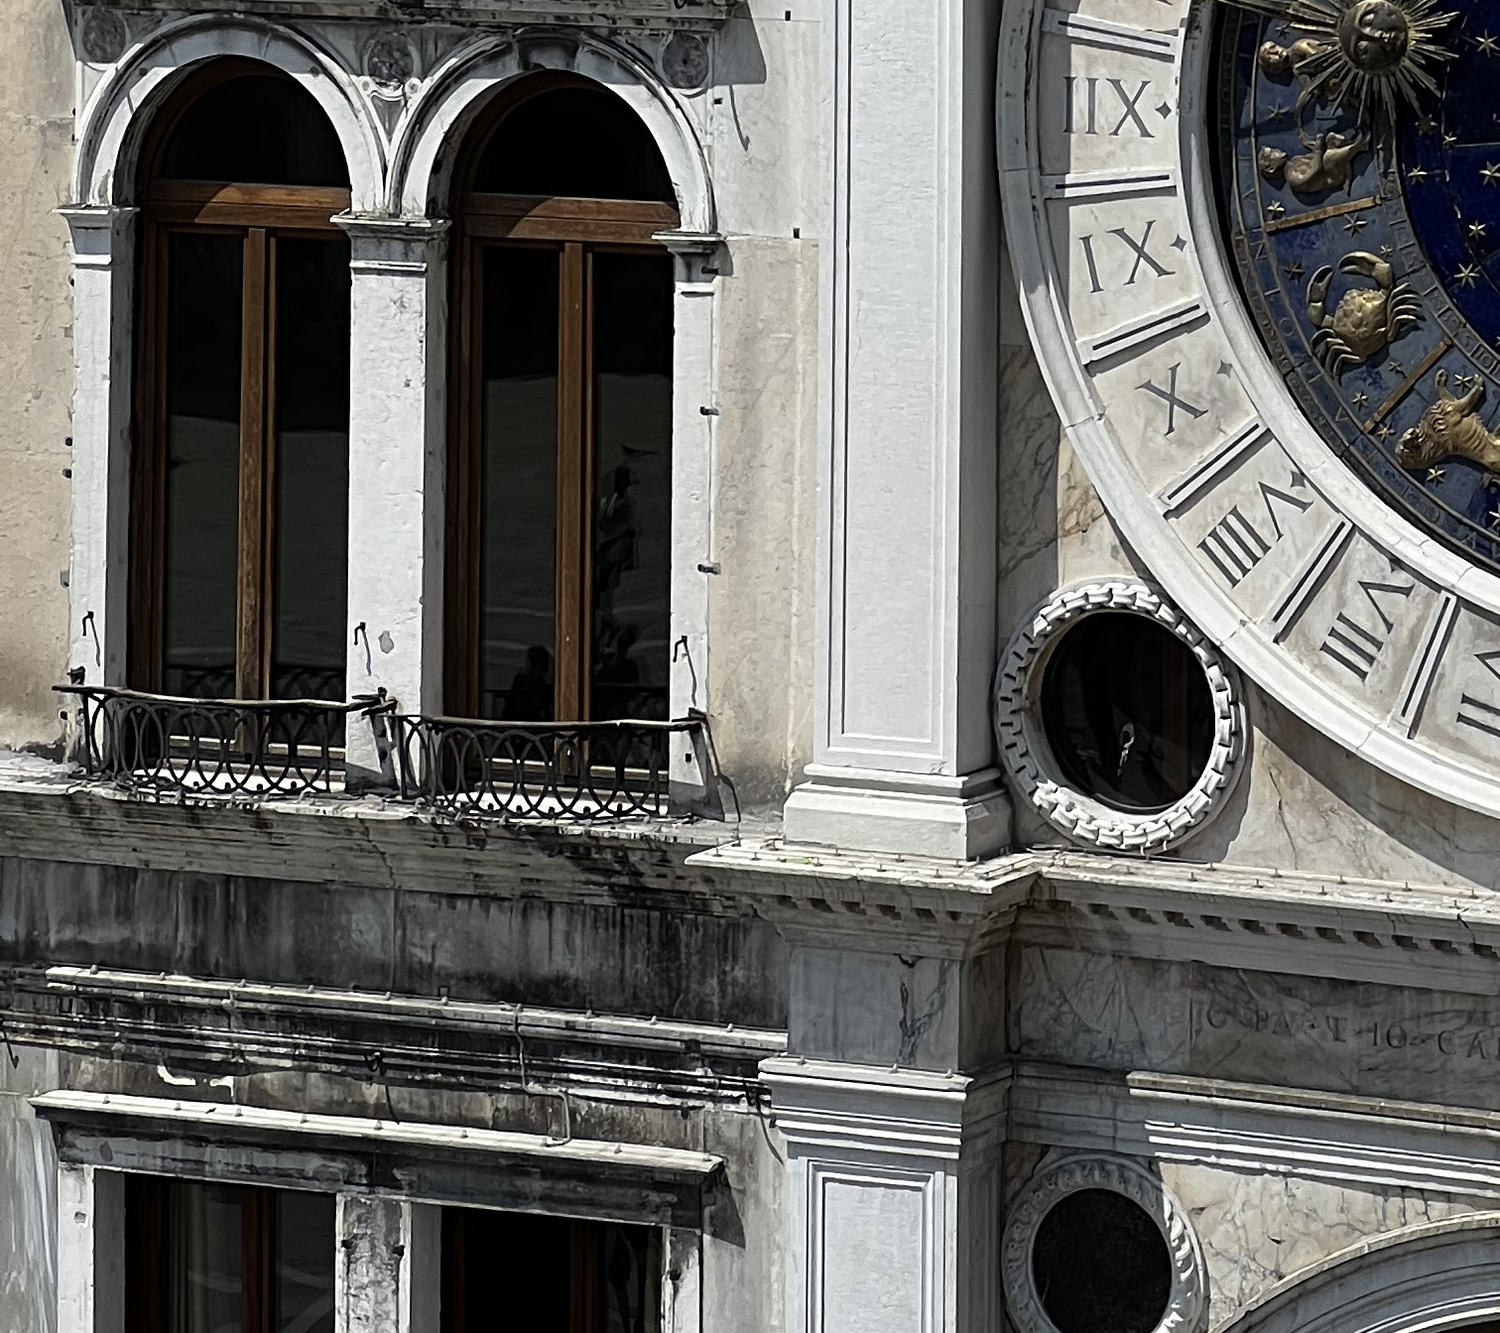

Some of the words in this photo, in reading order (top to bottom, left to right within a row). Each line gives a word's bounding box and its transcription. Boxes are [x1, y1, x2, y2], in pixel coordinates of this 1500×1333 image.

[1134, 361, 1210, 437] X
[1196, 480, 1315, 589] VIIII
[1319, 579, 1416, 687] VIII
